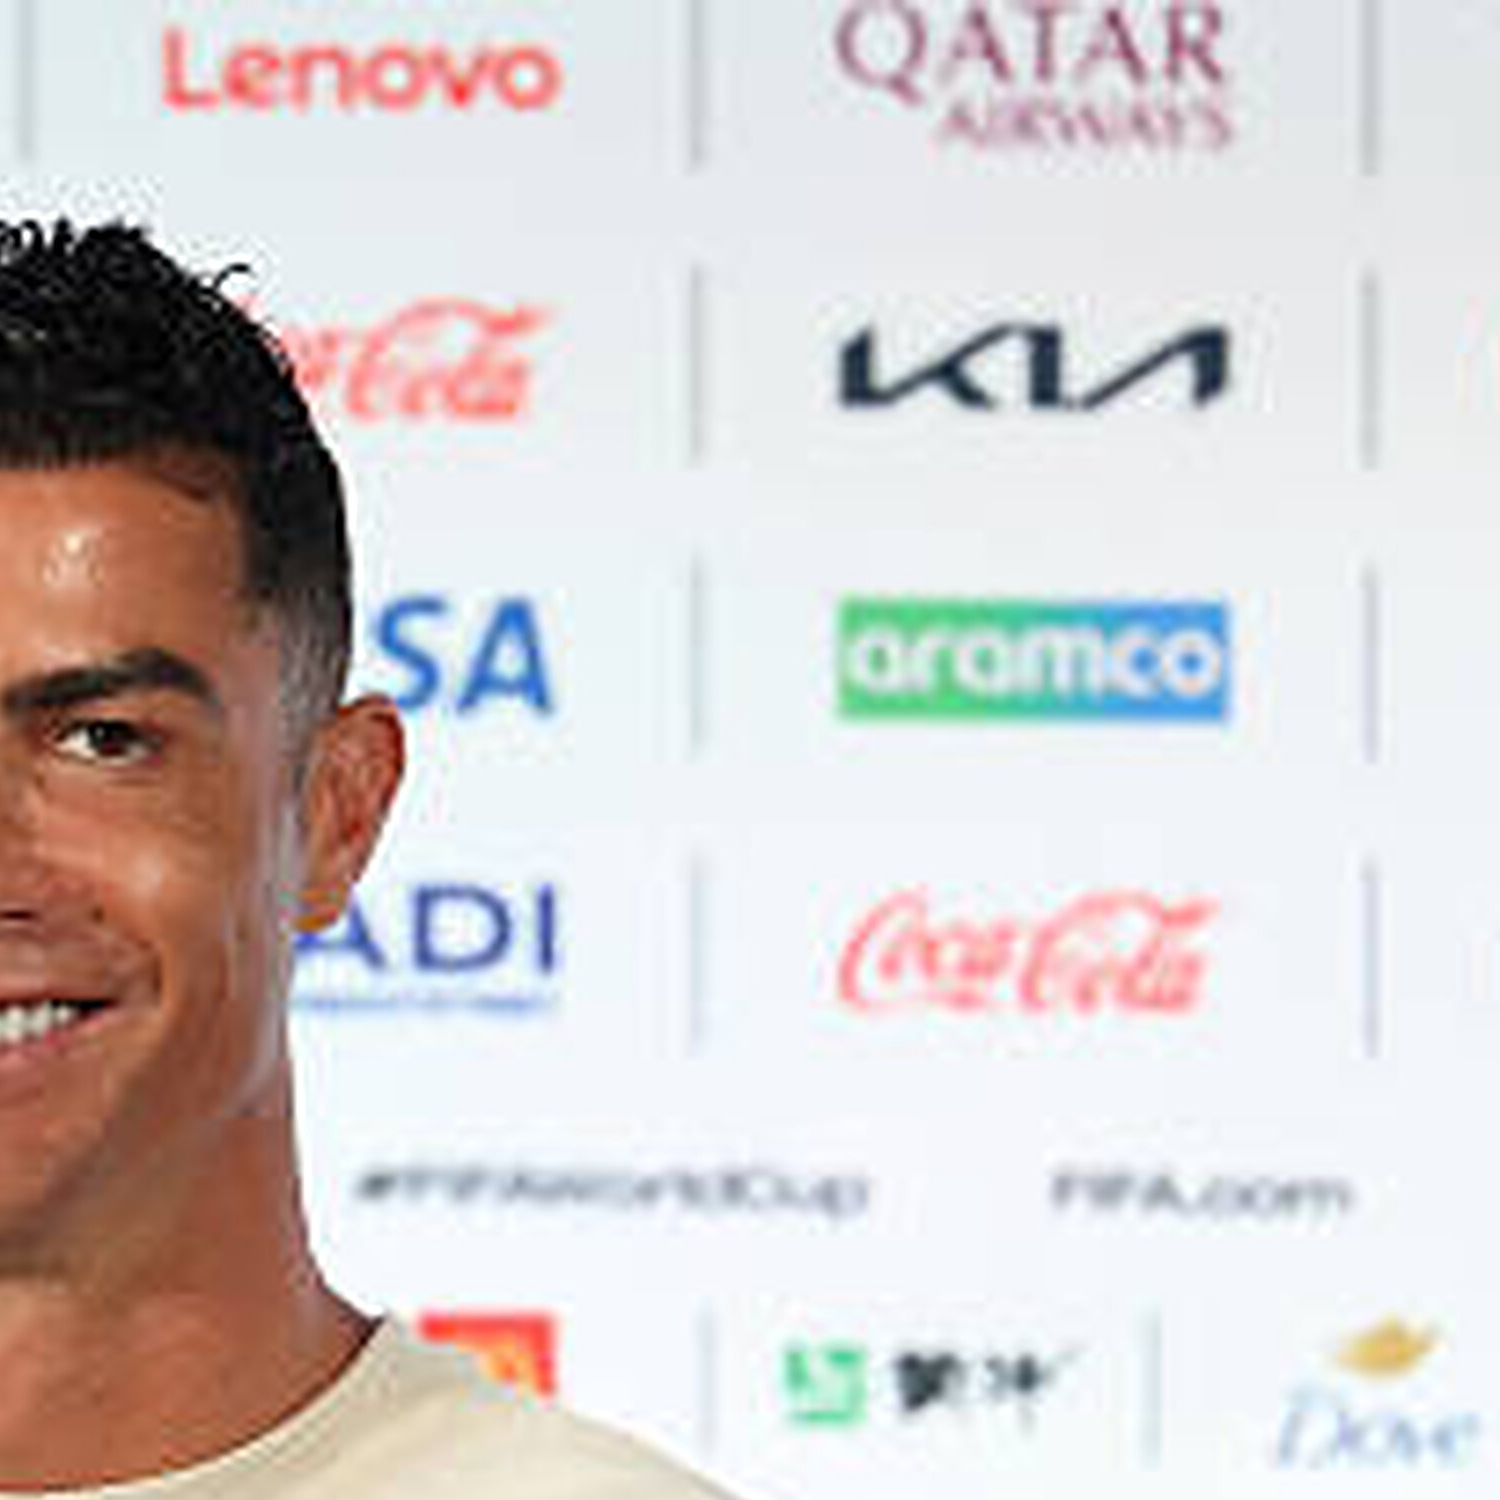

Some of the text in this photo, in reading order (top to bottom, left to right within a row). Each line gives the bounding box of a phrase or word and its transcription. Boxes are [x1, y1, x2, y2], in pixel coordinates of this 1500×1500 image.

[162, 26, 563, 112] Lenovo
[835, 0, 1228, 103] QATAR
[938, 102, 1235, 151] AIRWAYS
[373, 594, 555, 715] SA
[845, 627, 1222, 694] aramco
